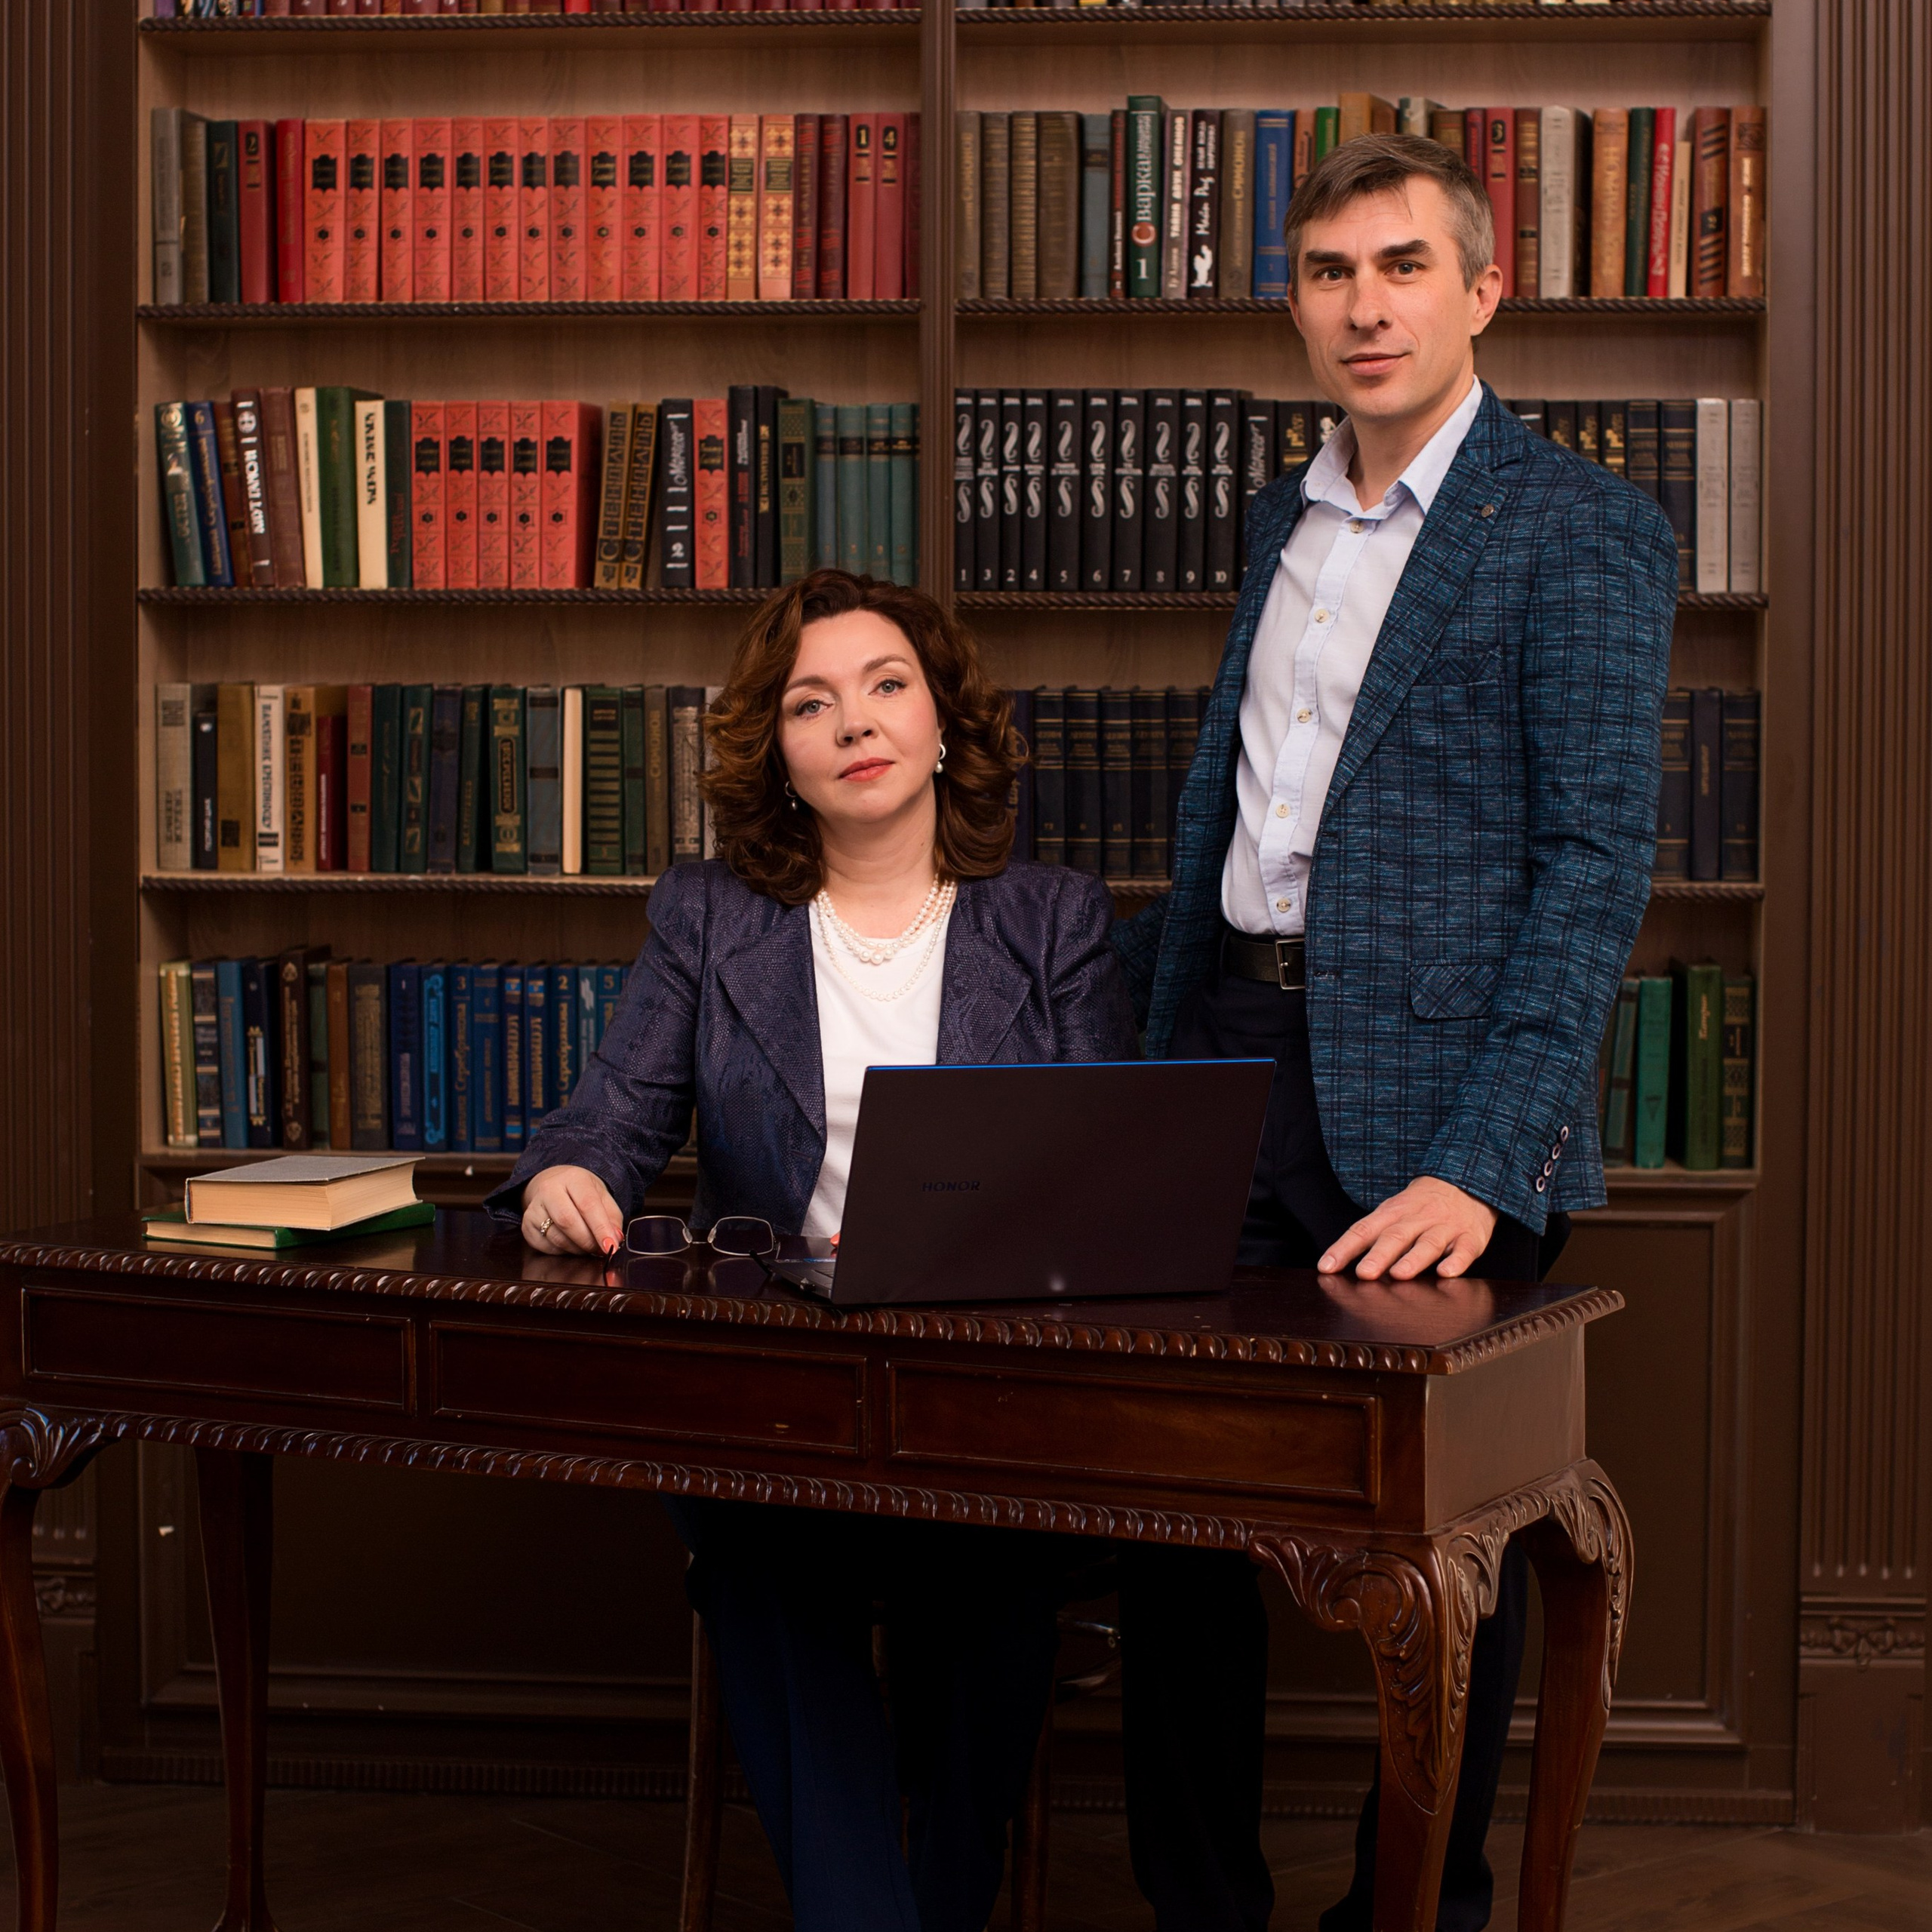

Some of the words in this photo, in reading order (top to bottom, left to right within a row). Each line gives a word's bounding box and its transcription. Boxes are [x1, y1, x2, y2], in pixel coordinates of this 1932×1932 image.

[860, 130, 866, 145] 1
[885, 131, 895, 145] 4
[1173, 116, 1185, 166] ОКЕАНОВ
[1171, 170, 1183, 199] ДВУХ
[1169, 203, 1181, 238] ТАЙНА
[1137, 258, 1148, 279] 1
[599, 413, 625, 561] СТЕНДАЛЬ
[626, 413, 653, 561] СТЕНДАЛЬ
[961, 568, 966, 581] 1
[984, 568, 992, 580] 3
[1007, 568, 1015, 582] 2
[1029, 569, 1038, 580] 4
[1060, 570, 1068, 583] 5
[1093, 570, 1102, 582] 6
[1123, 569, 1131, 582] 7
[1186, 571, 1195, 583] 9
[1215, 571, 1227, 583] 10
[558, 976, 568, 989] 2
[921, 1181, 980, 1192] HONOR
